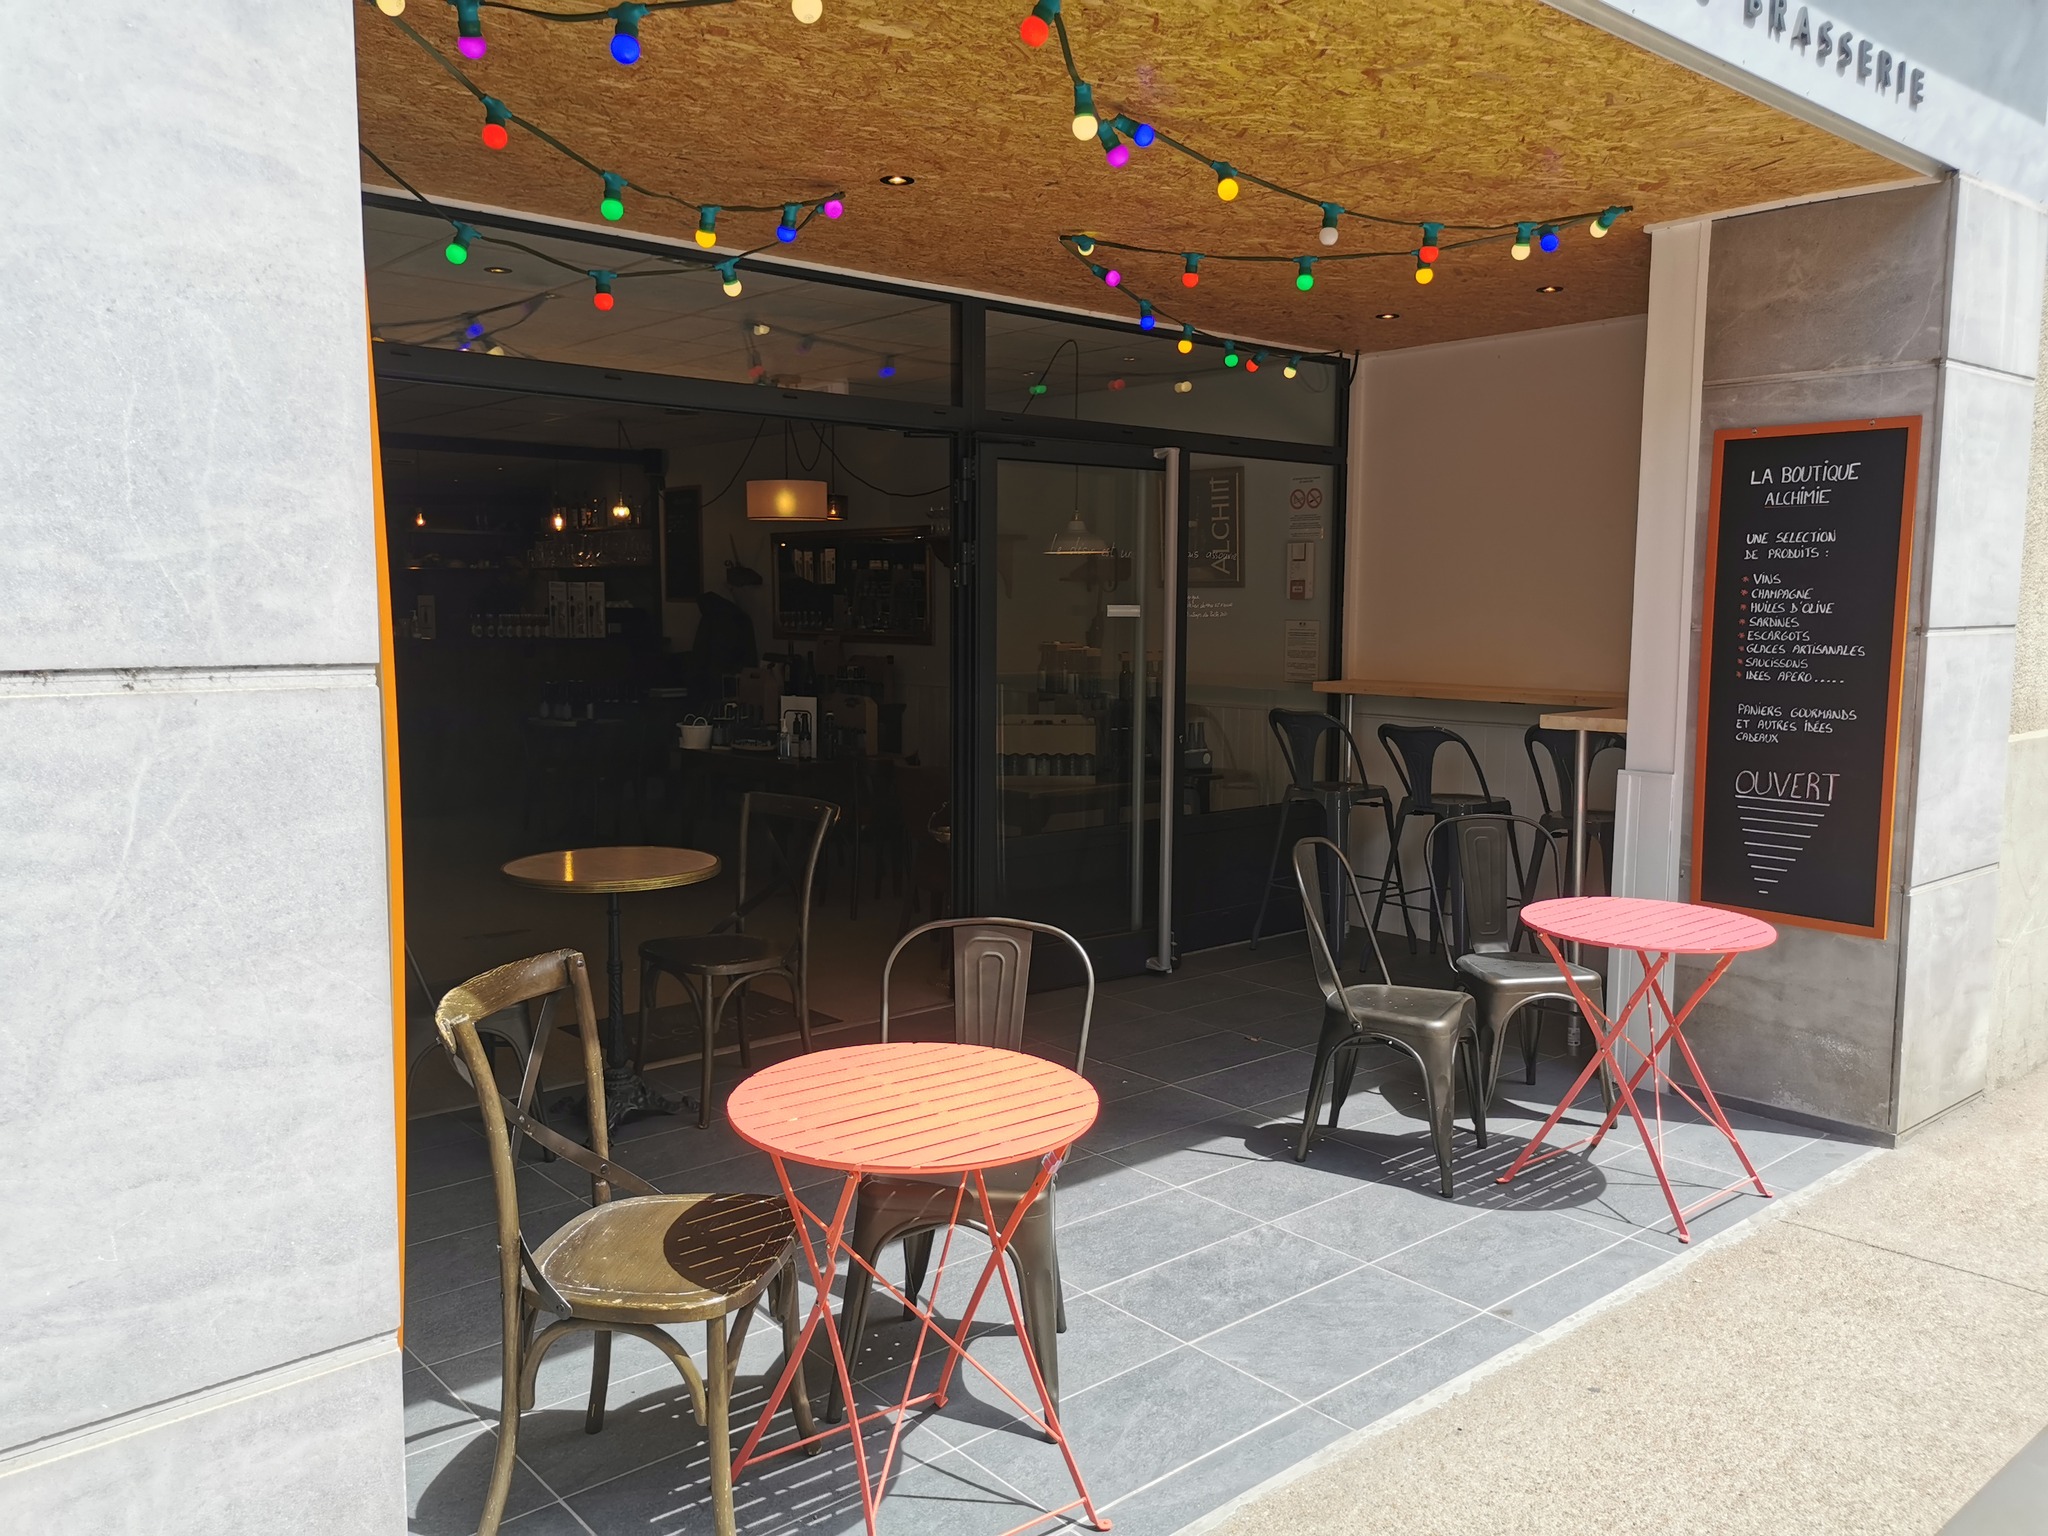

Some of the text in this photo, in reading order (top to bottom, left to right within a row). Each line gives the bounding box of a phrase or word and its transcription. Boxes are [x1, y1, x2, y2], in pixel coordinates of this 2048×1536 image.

[1750, 460, 1861, 485] LA BOUTIQUE
[1764, 486, 1832, 506] ALCHIMIE
[1746, 528, 1836, 544] UNE SELECTION
[1744, 549, 1758, 560] DE
[1768, 545, 1820, 559] PRODUITS
[1753, 572, 1782, 585] VINS
[1751, 587, 1814, 600] CHAMPAGNE
[1750, 600, 1835, 614] HUILES D'OLIVE
[1749, 616, 1800, 628] SARDINES
[1747, 630, 1810, 642] ESCARGOTS
[1746, 642, 1866, 657] GLACES ARTISANALES
[1745, 657, 1809, 669] SAUCISSONS
[1746, 670, 1771, 681] IDEES
[1737, 702, 1857, 720] PANIERS GOURMANDS
[1736, 718, 1750, 729] ET
[1757, 720, 1797, 732] AUTRES
[1735, 732, 1779, 743] CADEAUX
[1735, 770, 1841, 802] OUVERT
